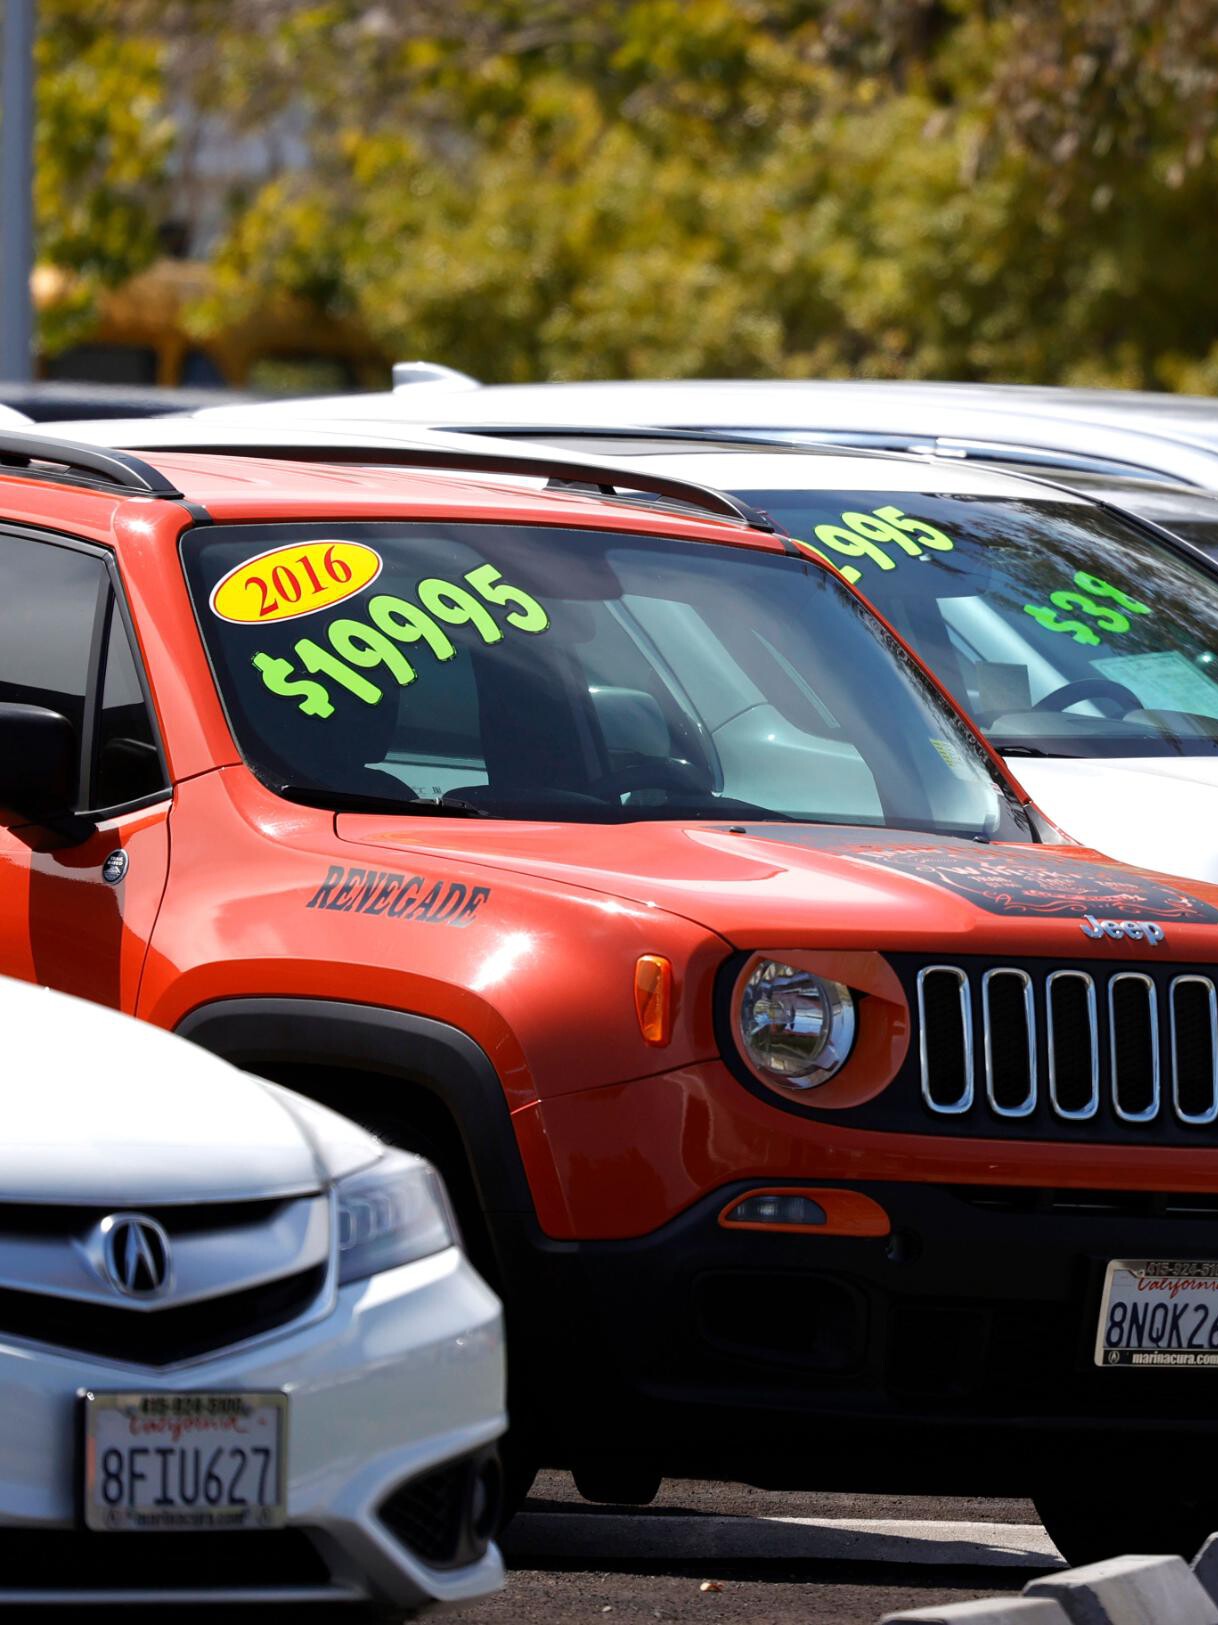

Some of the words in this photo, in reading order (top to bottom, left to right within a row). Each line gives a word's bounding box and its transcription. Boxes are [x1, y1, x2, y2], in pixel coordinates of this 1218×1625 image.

[791, 505, 955, 585] 995
[243, 544, 354, 617] 2016
[250, 563, 551, 719] $19995
[306, 865, 491, 928] RENEGADE
[1080, 914, 1165, 946] Jeep
[102, 1447, 272, 1506] 8FIU627
